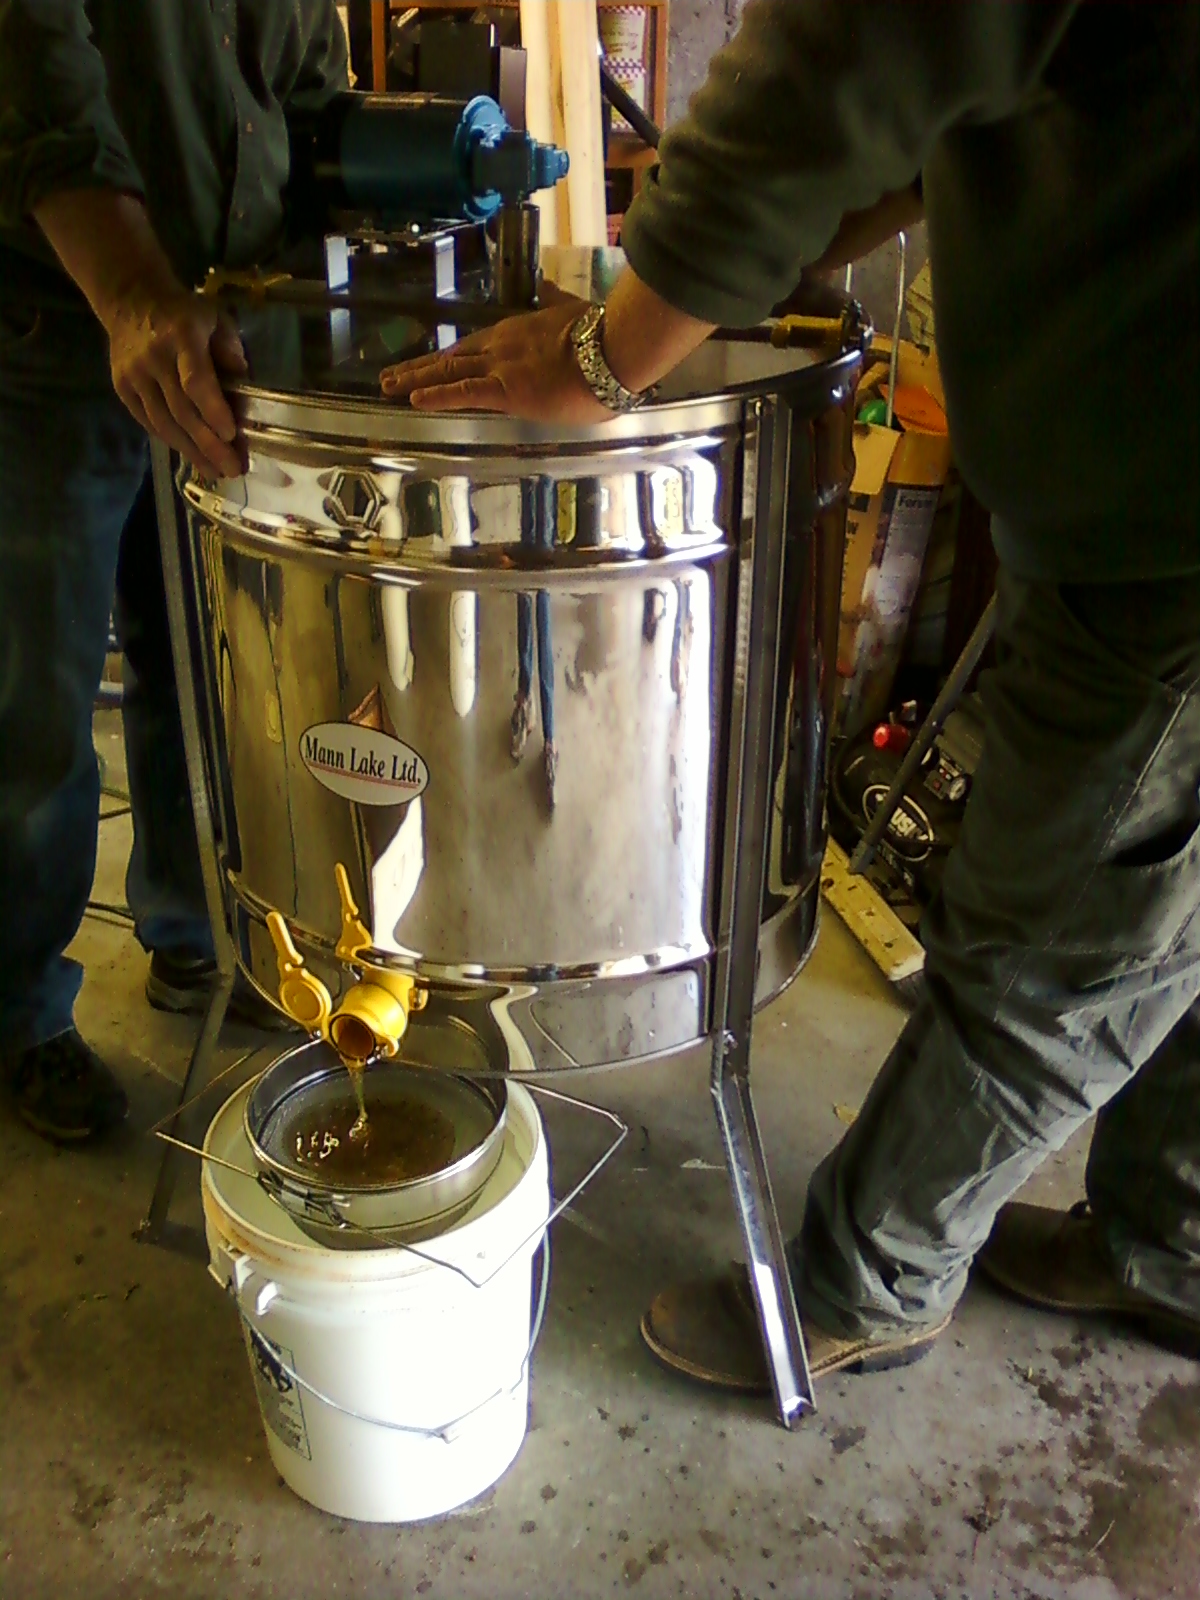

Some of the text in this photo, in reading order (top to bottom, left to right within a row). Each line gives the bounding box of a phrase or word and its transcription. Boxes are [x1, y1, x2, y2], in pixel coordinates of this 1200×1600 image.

[304, 734, 422, 784] Mann Lake Ltd.
